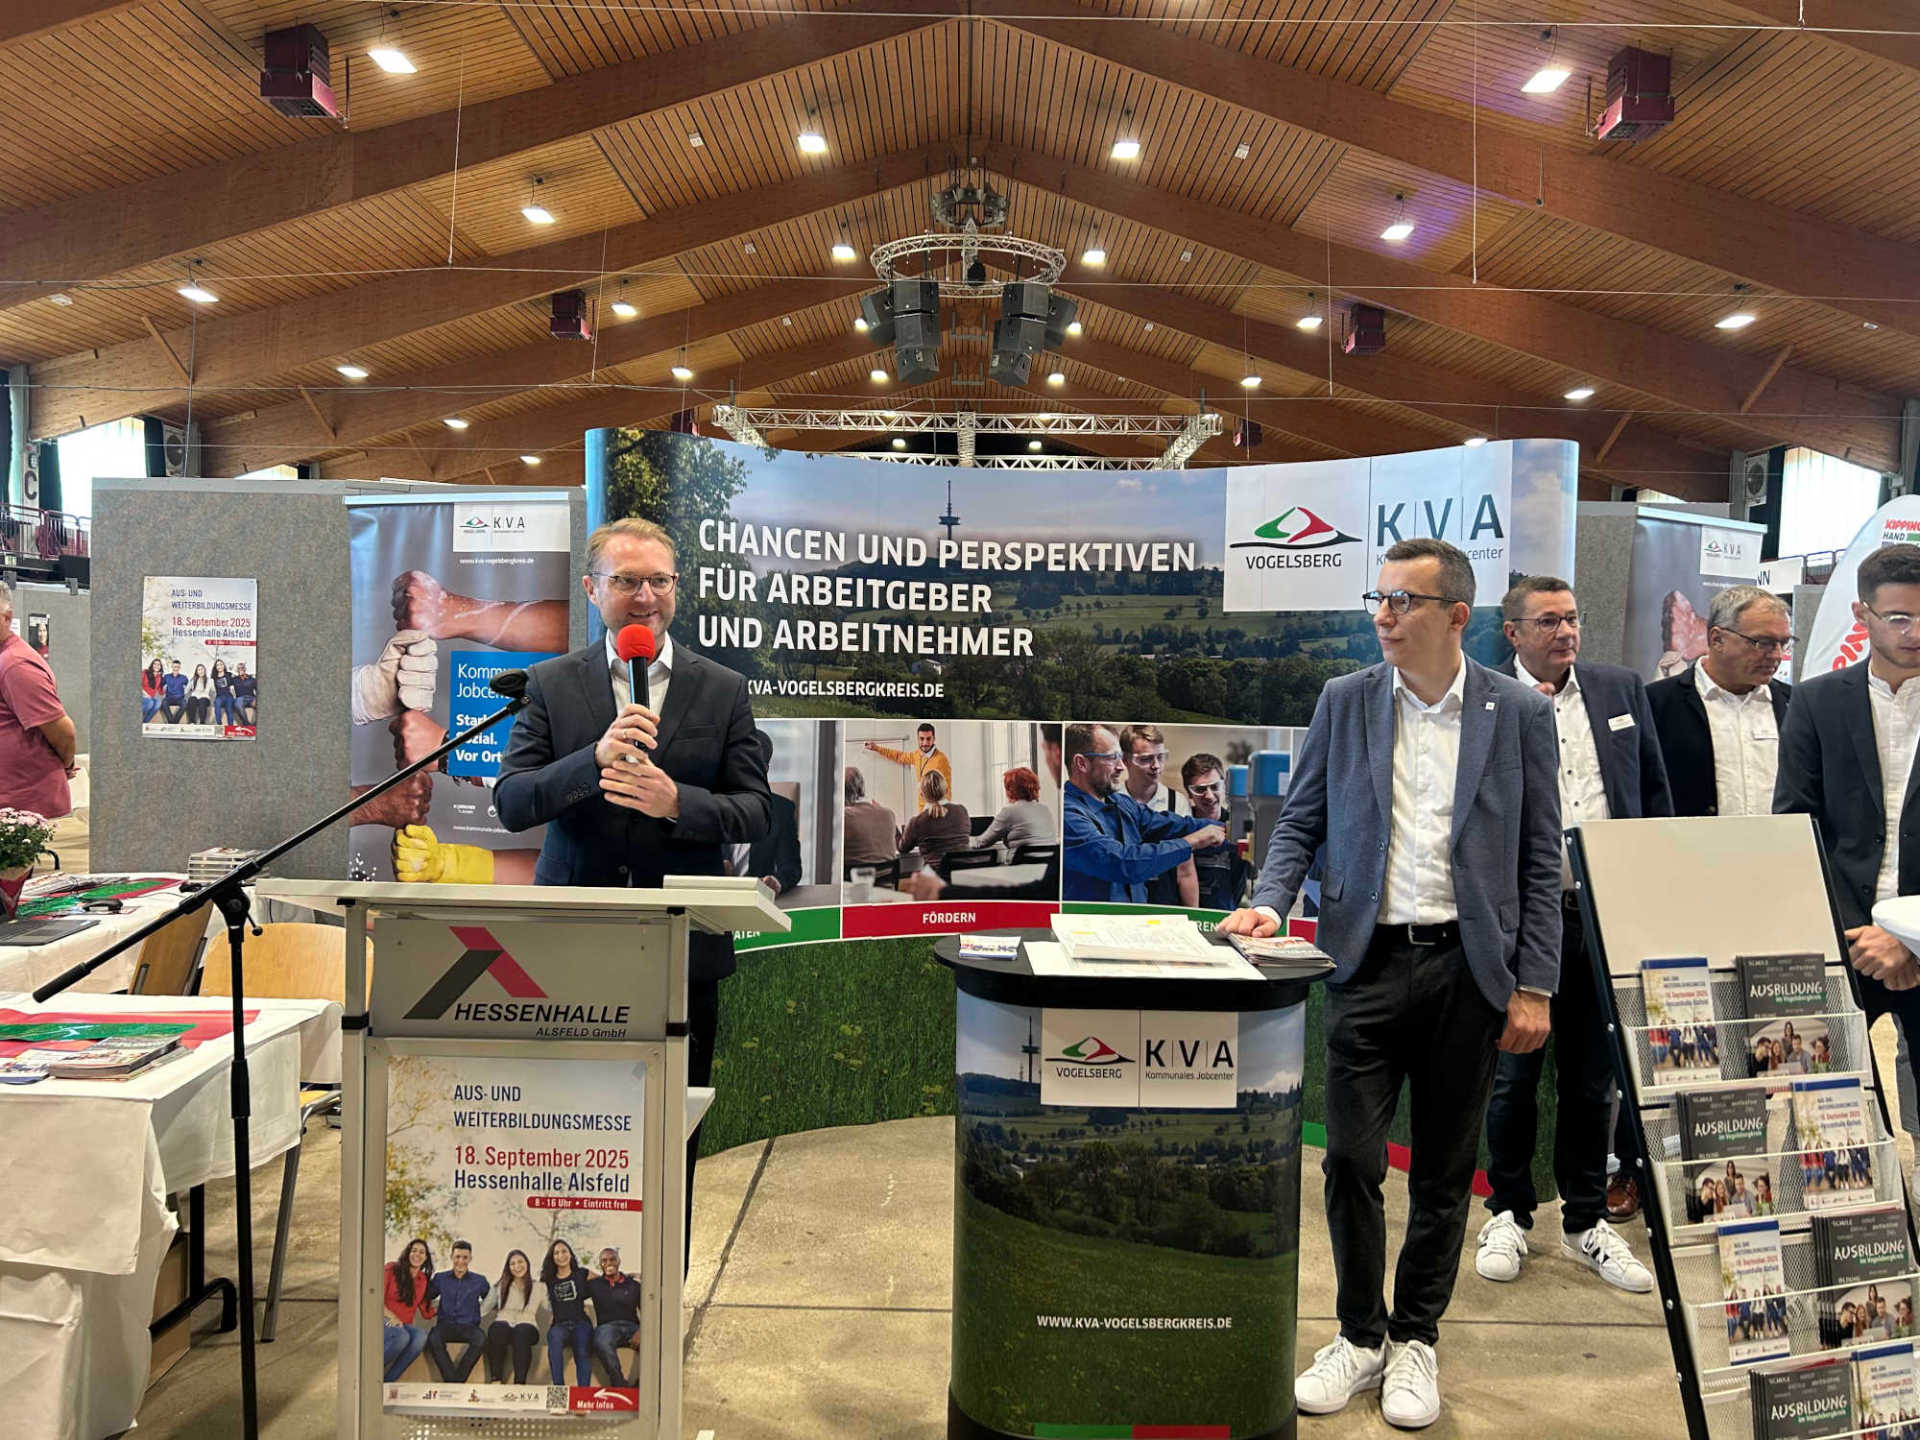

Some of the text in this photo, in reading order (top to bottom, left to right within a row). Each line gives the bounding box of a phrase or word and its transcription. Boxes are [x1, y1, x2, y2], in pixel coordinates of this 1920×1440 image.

[699, 518, 1195, 572] CHANCEN UND PERSPEKTIVEN
[1246, 553, 1342, 569] VOGELSBERG
[188, 589, 203, 598] UND
[699, 562, 992, 613] FÜR ARBEITGEBER
[171, 601, 252, 611] WEITERBILDUNGSMESSE
[186, 616, 229, 628] September
[231, 617, 251, 627] 2025
[172, 628, 251, 639] Hessenhalle Alsfeld
[699, 615, 1034, 657] UND ARBEITNEHMER
[456, 750, 478, 762] Vor
[922, 910, 976, 925] FÖRDERN
[453, 1003, 631, 1024] HESSENHALLE
[536, 1027, 627, 1038] ALSFELD GmbH
[1056, 1067, 1122, 1079] VOGELSBERG
[1145, 1071, 1234, 1081] Kommunales Jobcenter
[454, 1085, 521, 1101] AUS- UND
[454, 1111, 632, 1131] WEITERBILDUNGSMESSE
[455, 1145, 629, 1170] 18. September 2025
[455, 1169, 629, 1193] Hessenhalle Alsfeld
[583, 1200, 613, 1209] Eintritt
[1036, 1314, 1233, 1331] WWW.KVA-VOGELSBERGKREIS.DE
[577, 1400, 614, 1409] Mehr Infos
